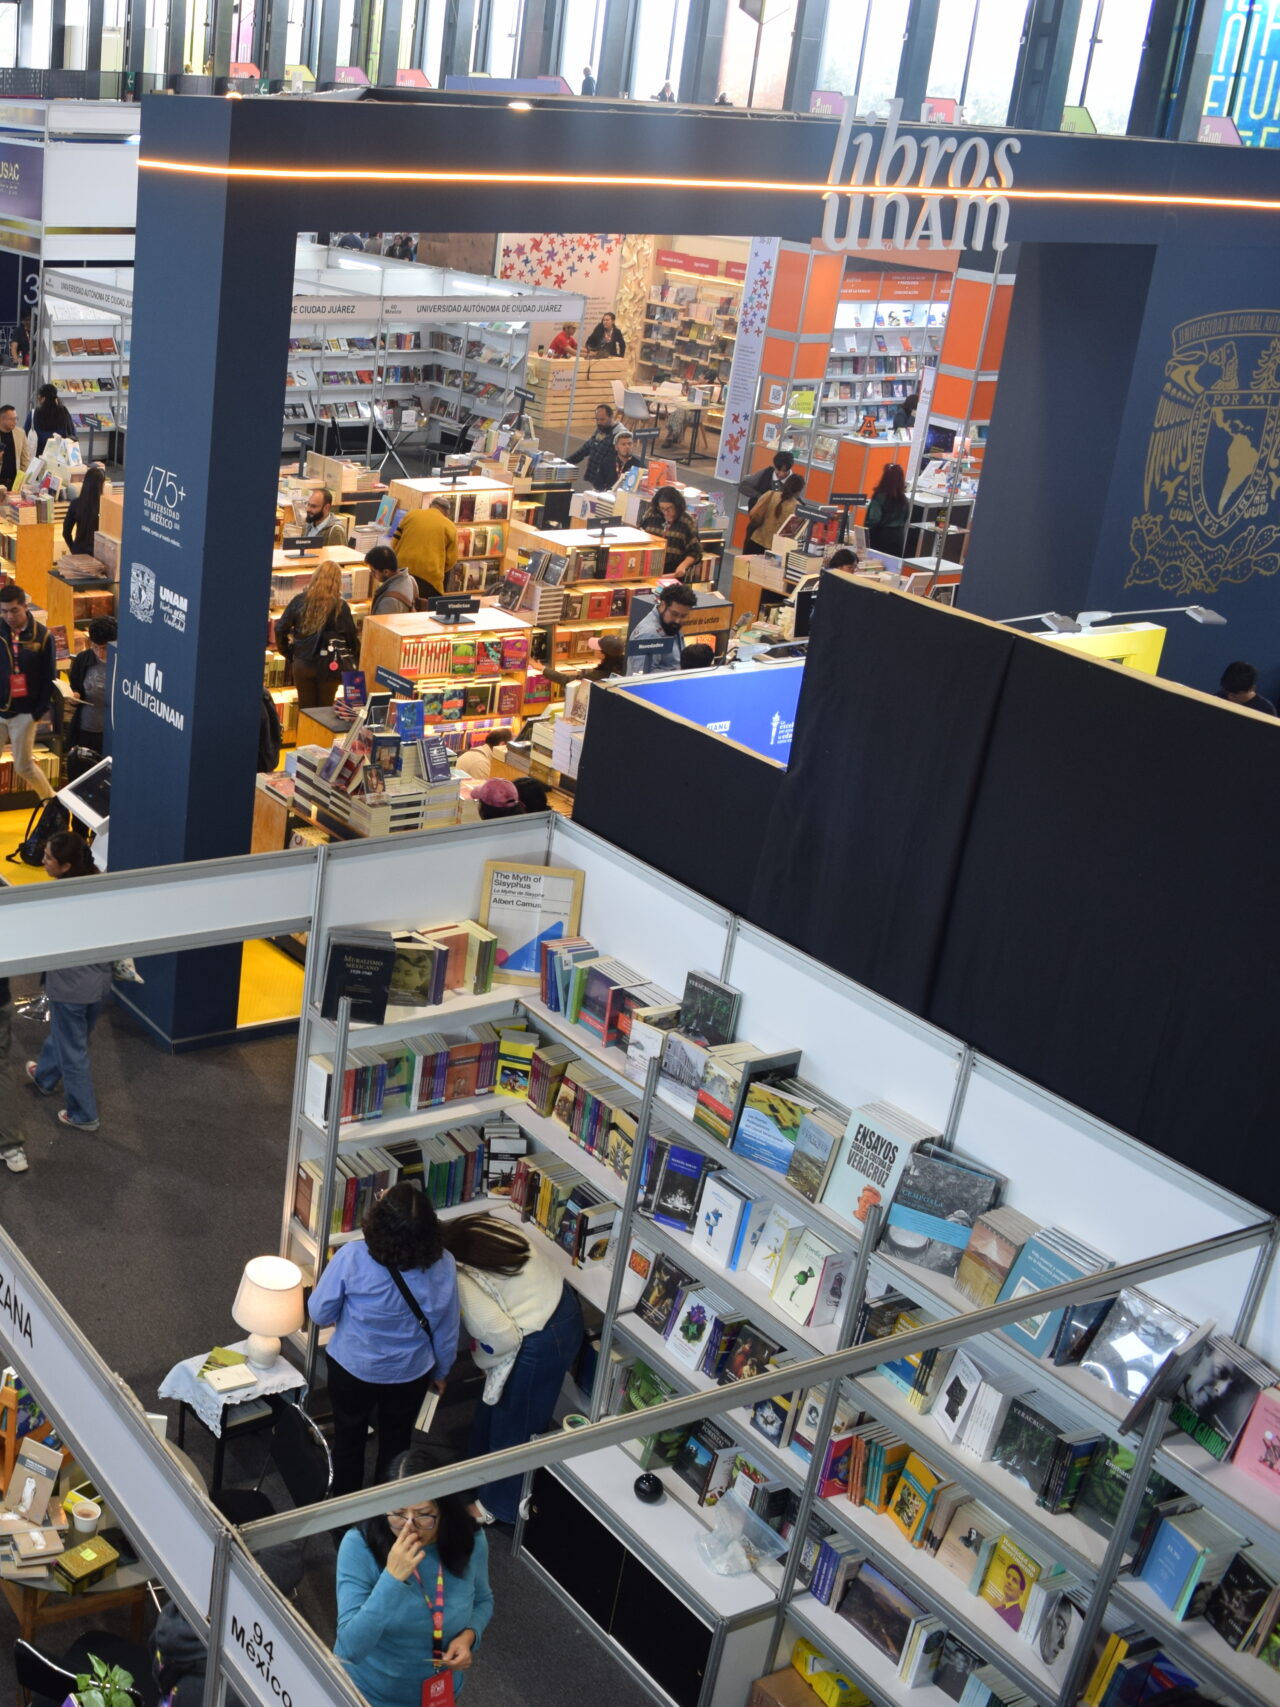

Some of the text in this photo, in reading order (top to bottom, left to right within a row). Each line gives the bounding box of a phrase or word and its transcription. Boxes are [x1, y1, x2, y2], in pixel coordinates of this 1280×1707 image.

[827, 96, 1022, 189] libros
[60, 282, 84, 297] UNIVERSIDAD
[299, 305, 327, 314] CIUDAD
[416, 304, 462, 314] UNIVERSIDAD
[463, 303, 500, 313] AUTÓNOMA
[501, 304, 510, 313] DE
[511, 304, 536, 313] CIUDAD
[1178, 314, 1263, 344] UNIVERSIDAD NACIONAL
[1214, 394, 1240, 406] POR
[143, 465, 186, 508] 475+
[150, 511, 173, 531] MÉXICO
[160, 585, 188, 613] UNAM
[122, 678, 184, 731] culturaUNAM
[494, 871, 542, 885] The Myth of
[494, 879, 531, 890] Sisyphus
[492, 897, 542, 909] Albert Camus
[344, 955, 383, 966] MURALISMO
[345, 963, 380, 972] MEXICANO
[851, 1140, 866, 1155] SOBRE
[870, 1150, 887, 1169] CULTURA
[854, 1123, 899, 1165] ENSAYOS
[846, 1150, 889, 1189] VERACRUZ
[1012, 1406, 1045, 1431] VERACRUZ
[252, 1620, 276, 1663] 94
[231, 1615, 293, 1707] México
